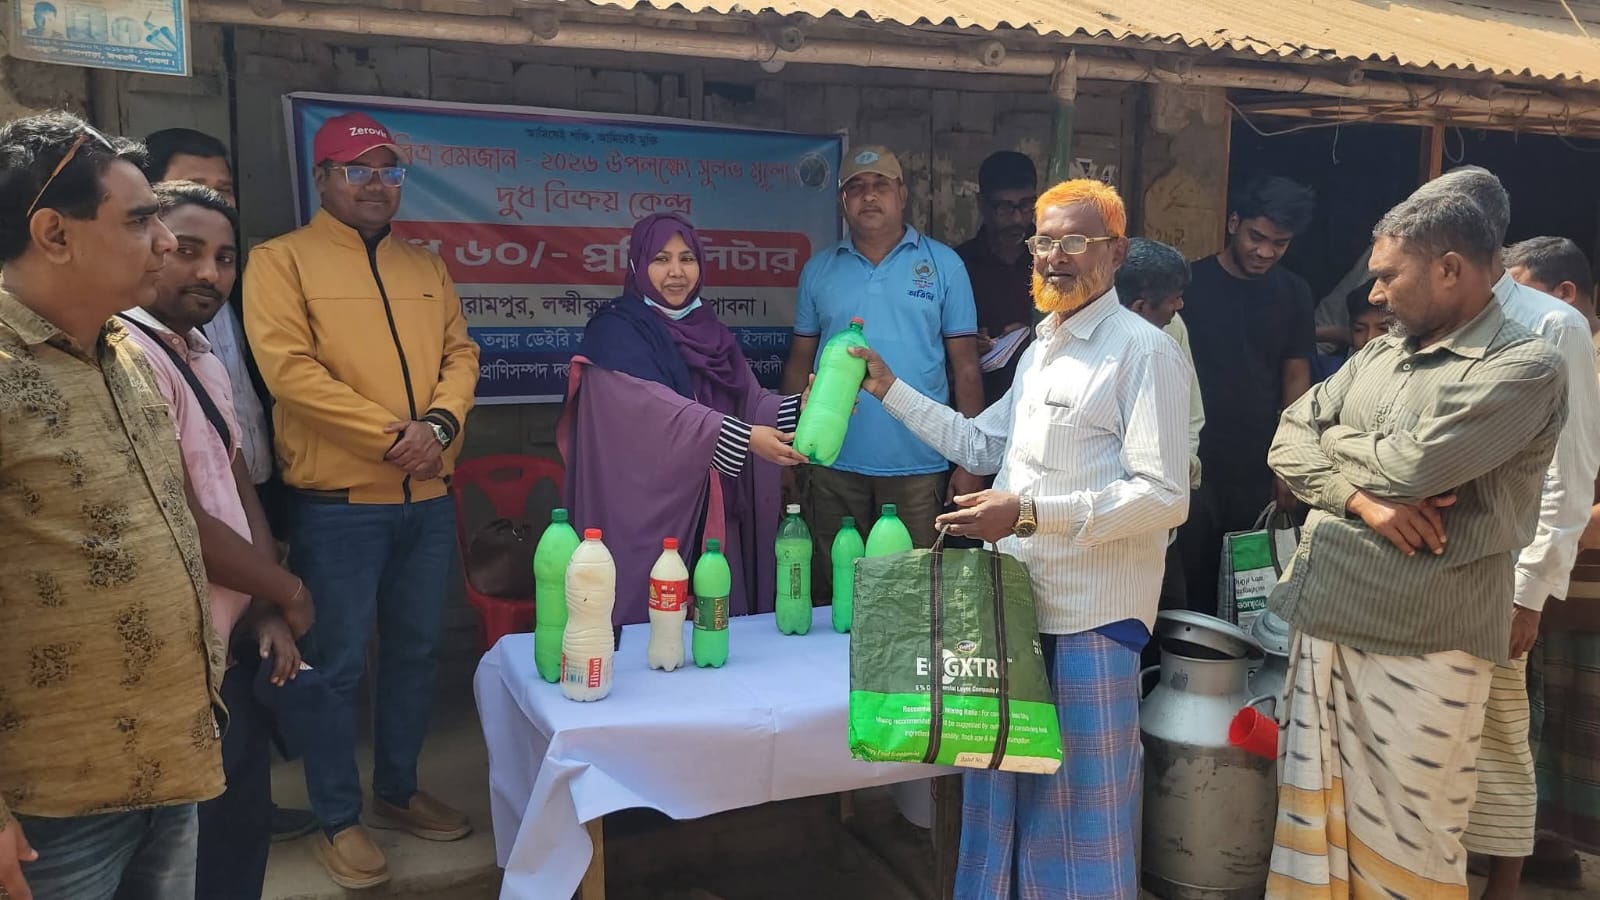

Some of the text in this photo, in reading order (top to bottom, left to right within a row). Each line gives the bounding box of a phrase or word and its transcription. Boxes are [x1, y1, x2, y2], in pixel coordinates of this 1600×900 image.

[440, 146, 516, 172] রমজান
[541, 152, 598, 173] ২০২৬
[697, 159, 743, 190] সুলভ
[496, 185, 536, 220] দুধ
[526, 328, 573, 350] ডেইরি
[741, 328, 788, 347] ইসলাম
[480, 359, 549, 382] প্রাণিসম্পদ
